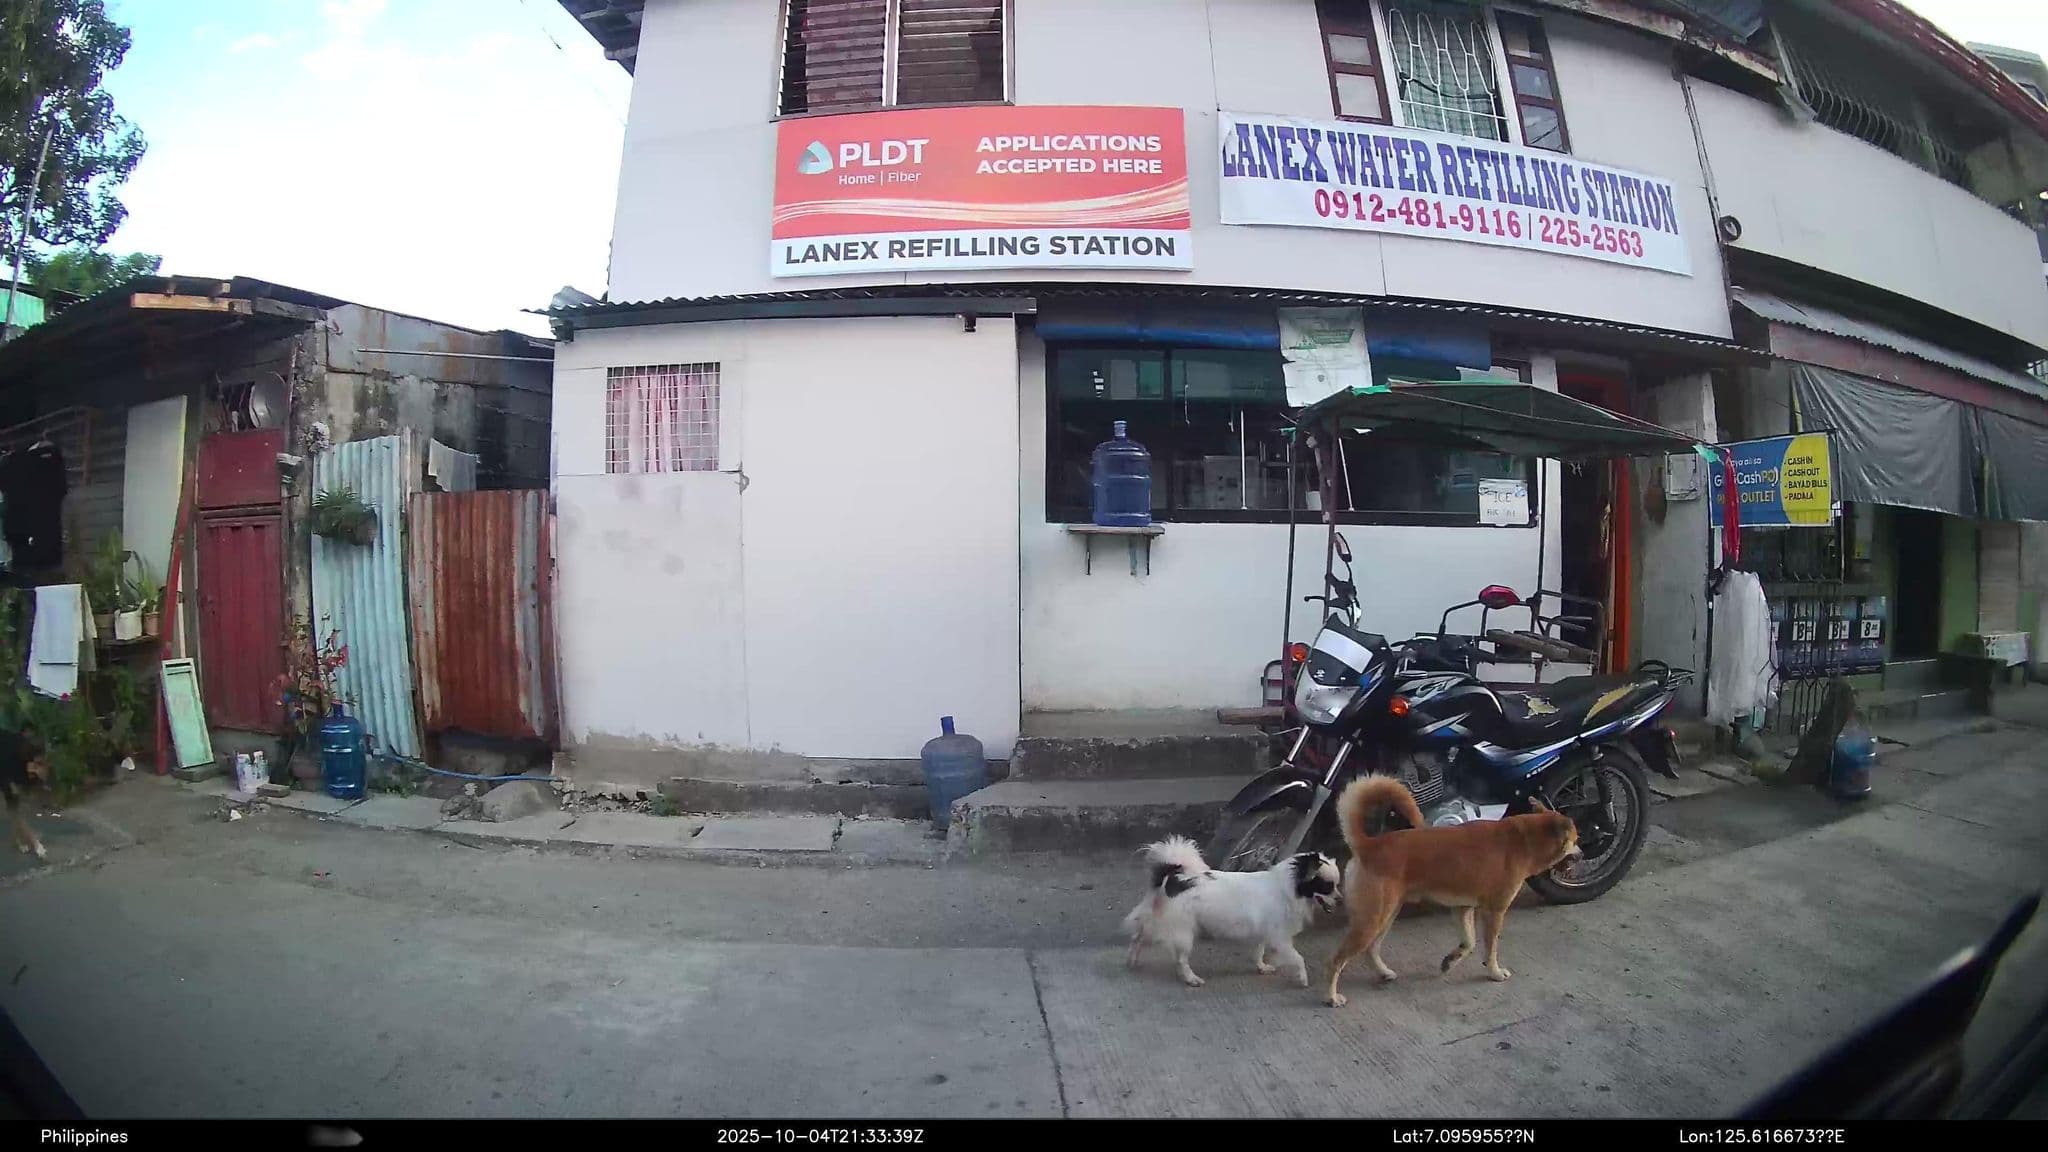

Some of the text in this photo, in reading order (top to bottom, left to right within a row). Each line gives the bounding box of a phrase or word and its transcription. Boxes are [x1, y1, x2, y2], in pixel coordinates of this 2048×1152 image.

[976, 134, 1162, 153] APPLICATIONS
[838, 138, 930, 168] PLDT
[976, 157, 1163, 175] ACCEPTED HERE
[838, 173, 876, 185] Home
[888, 171, 922, 183] Fiber
[1223, 123, 1679, 235] LANEX WATER REFILLING STATION
[1314, 188, 1522, 239] 0912-481-9116
[1539, 214, 1645, 258] 225-2563
[785, 235, 1176, 265] LANEX REFILLING STATION
[1787, 456, 1813, 465] CASH IN
[1788, 467, 1820, 477] CASH OUT
[1788, 480, 1828, 489] BAYAD BILLS
[1741, 490, 1776, 503] OUTLET
[1788, 492, 1814, 501] PADALA
